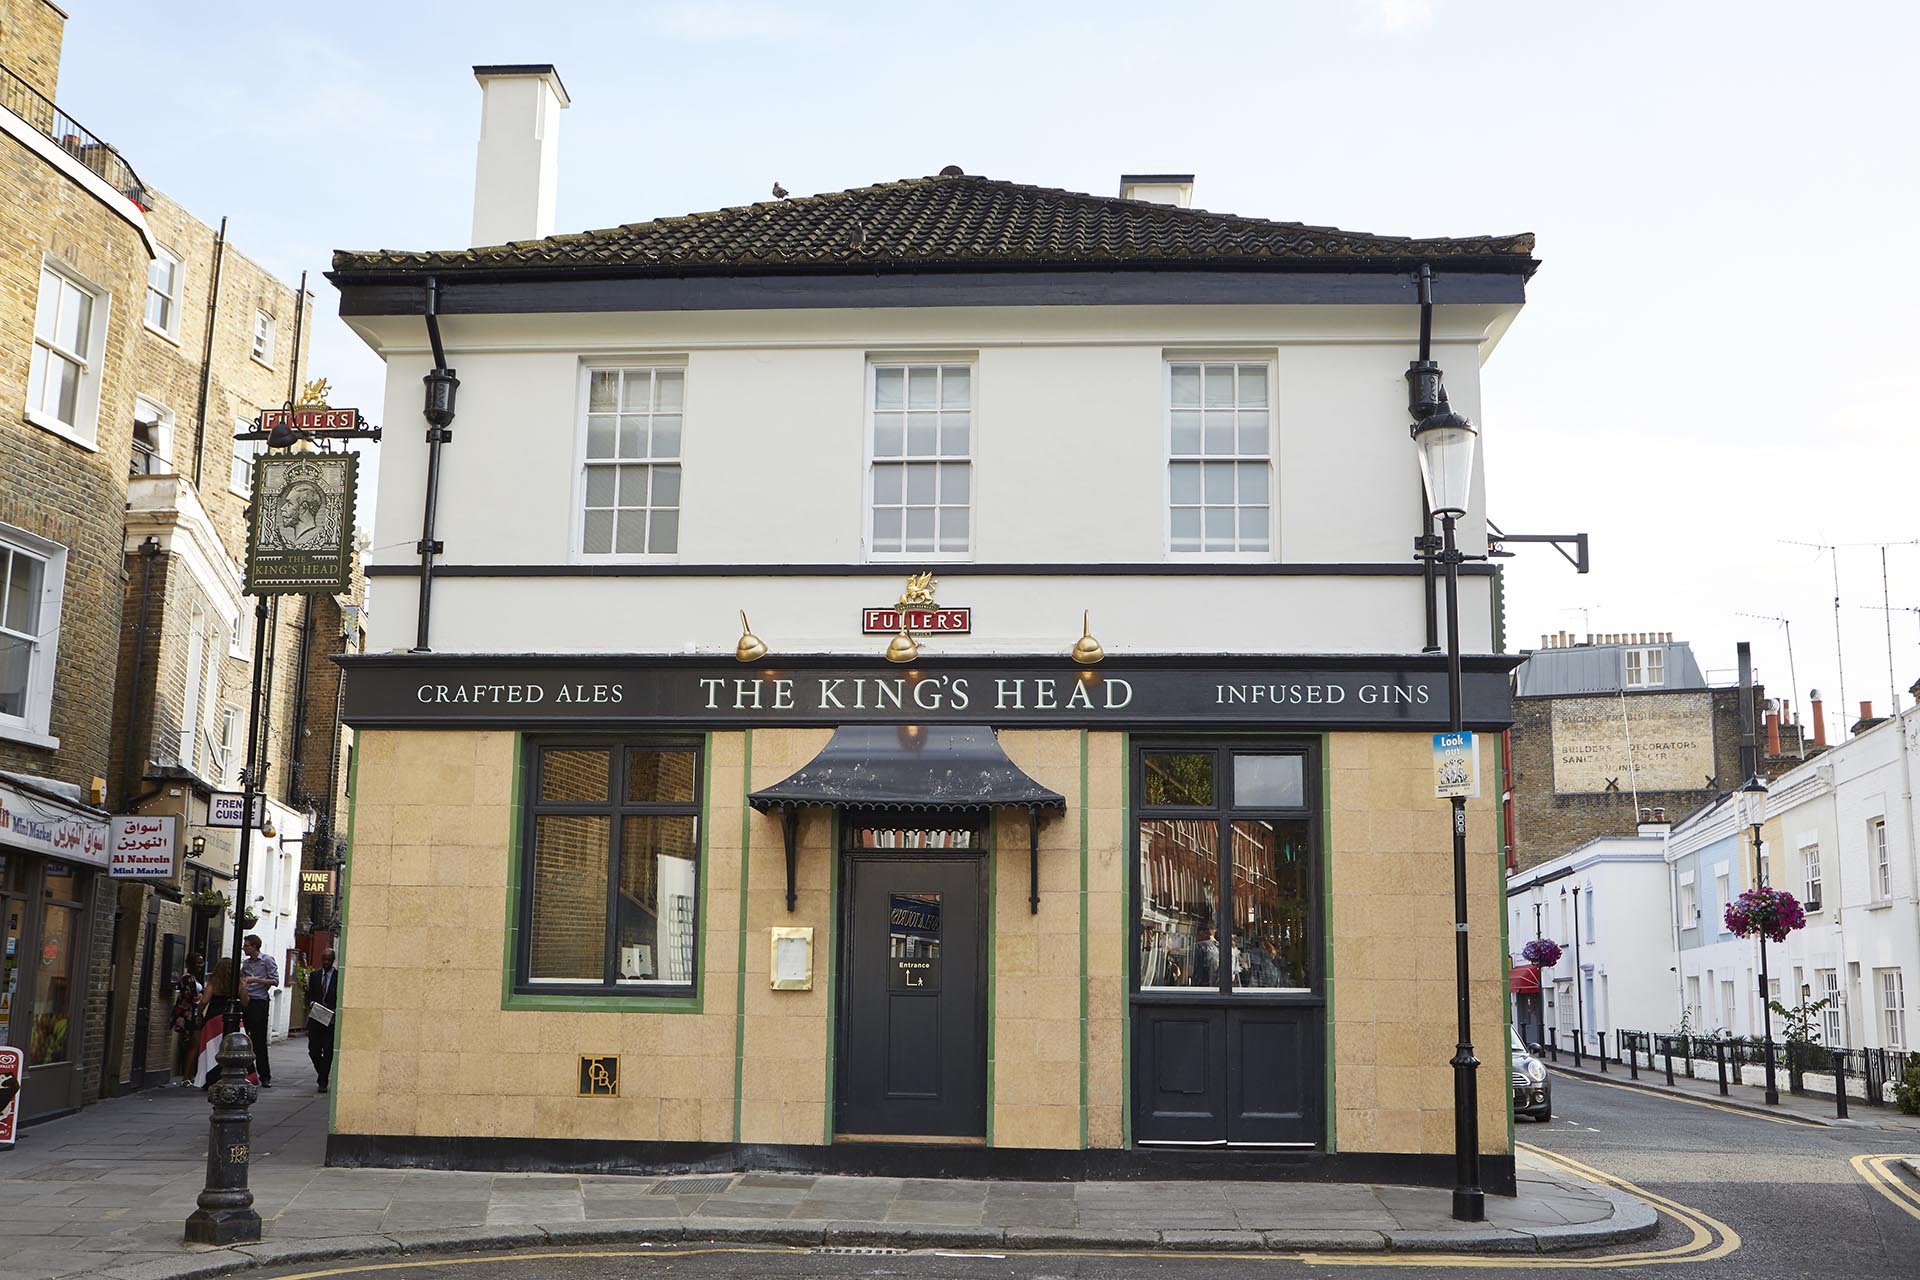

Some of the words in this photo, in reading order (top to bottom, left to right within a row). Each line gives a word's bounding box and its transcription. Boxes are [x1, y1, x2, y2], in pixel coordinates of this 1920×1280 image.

[288, 556, 306, 564] THE
[255, 565, 298, 575] KING'S
[302, 564, 338, 575] HEAD
[869, 611, 963, 630] FULLER'S
[417, 684, 544, 704] CRAFTED
[555, 684, 624, 704] ALES
[699, 678, 795, 710] THE
[817, 675, 970, 710] KING'S
[994, 678, 1134, 710] HEAD
[1215, 684, 1346, 704] INFUSED
[1358, 684, 1430, 704] GINS
[1441, 735, 1464, 747] Look
[1562, 745, 1612, 753] BUILDERS
[1629, 741, 1697, 751] DECORATORS
[216, 799, 257, 810] FRENH
[215, 810, 256, 820] CUISIE
[12, 815, 29, 836] Mini
[28, 820, 53, 843] Market
[112, 855, 125, 864] Al
[127, 855, 170, 864] Nahrein
[113, 867, 134, 875] Mini
[136, 867, 168, 875] Market
[302, 872, 329, 882] WINE
[303, 882, 325, 892] BAR
